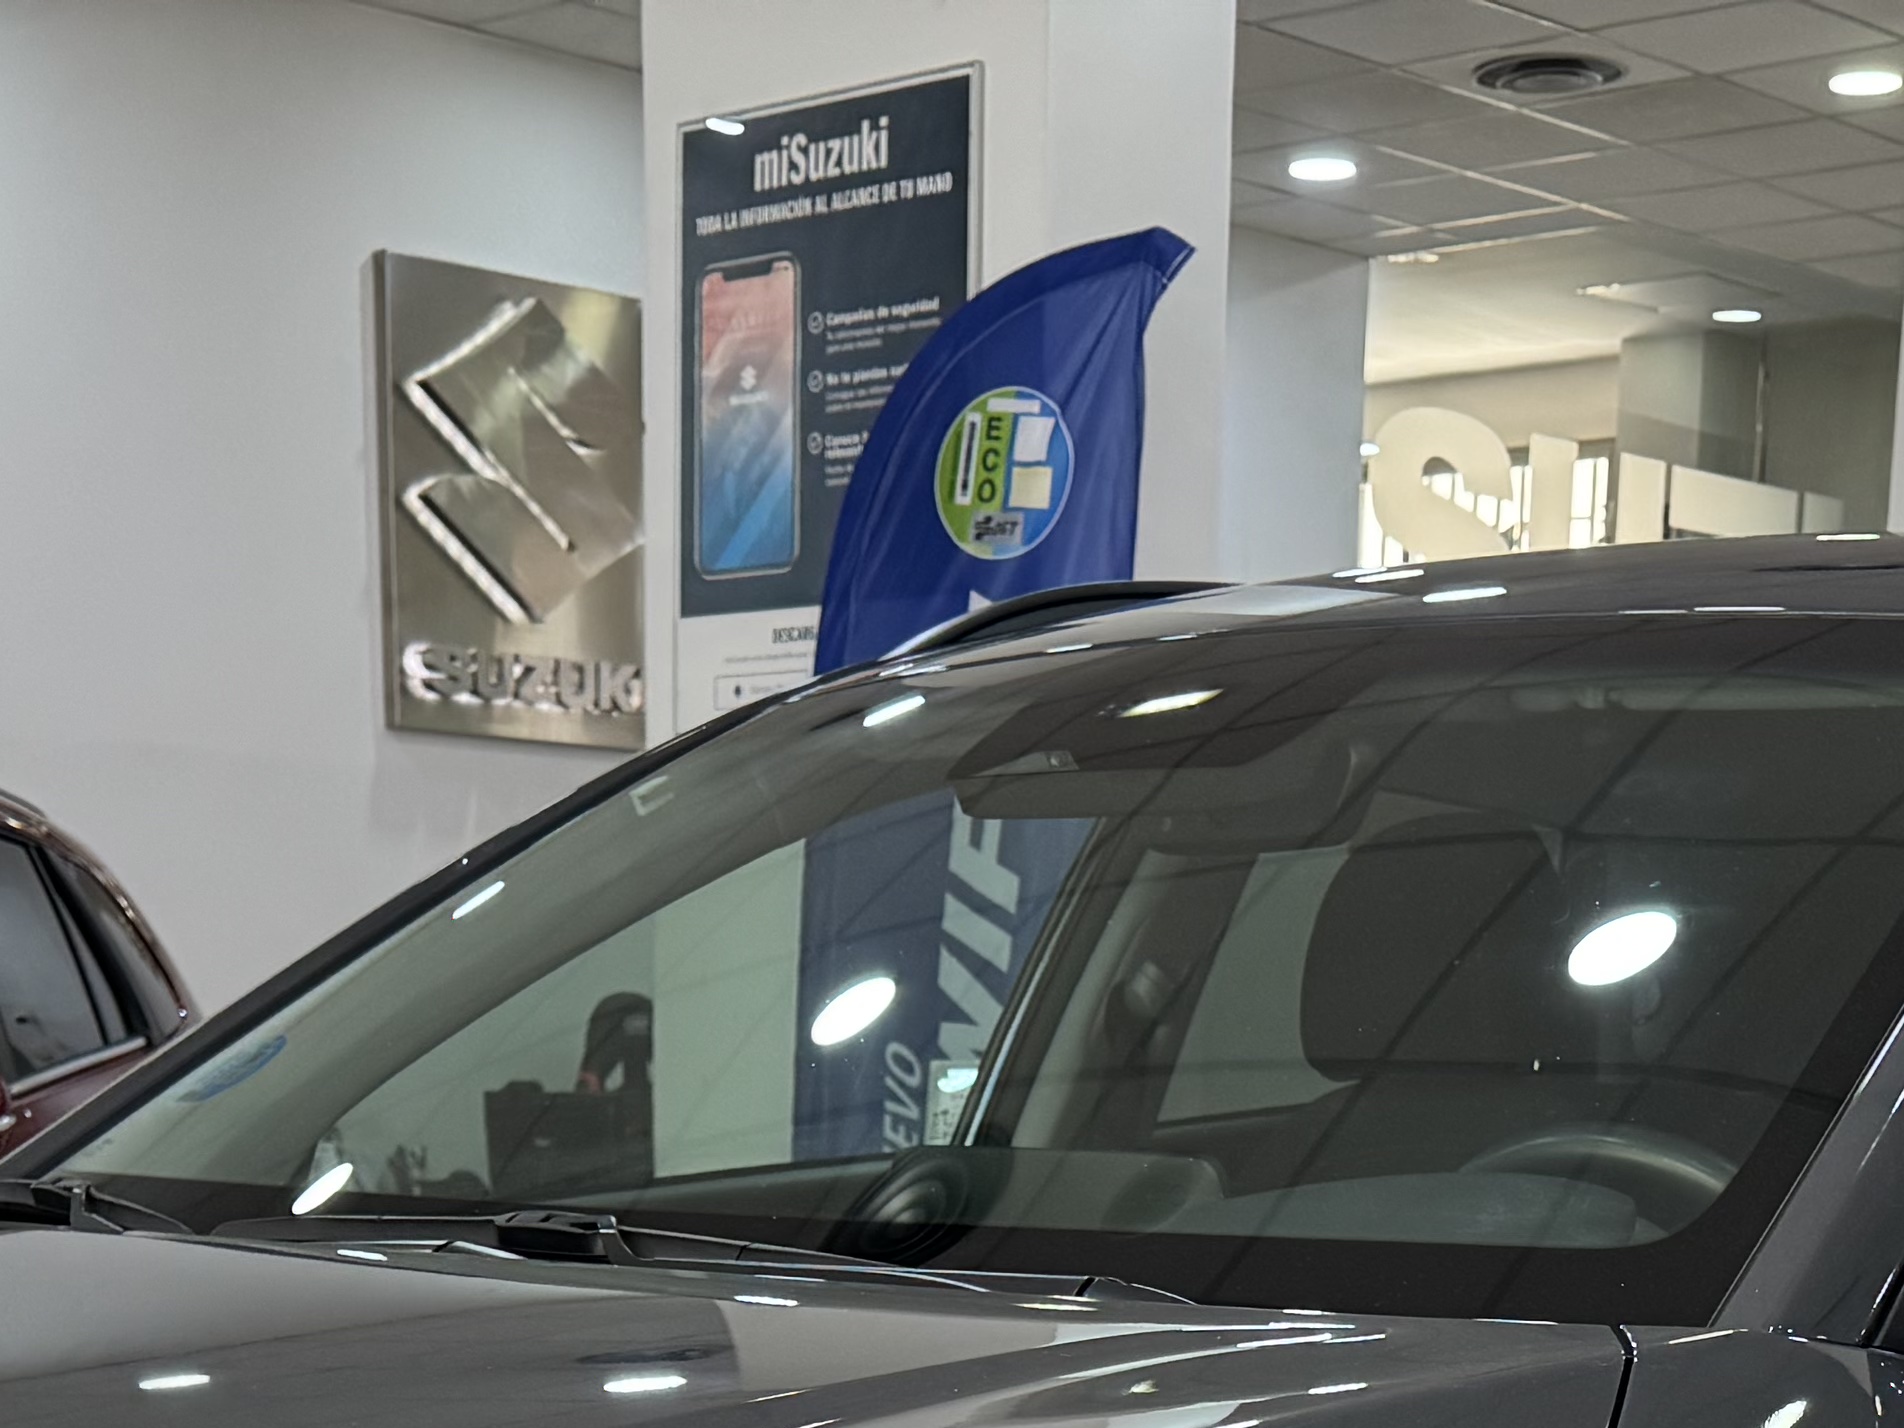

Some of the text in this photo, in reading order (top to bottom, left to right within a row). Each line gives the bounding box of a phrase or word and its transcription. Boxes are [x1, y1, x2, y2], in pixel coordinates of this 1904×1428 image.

[753, 115, 890, 193] miSuzuki
[723, 210, 739, 230] LA
[880, 181, 898, 204] DE
[898, 178, 915, 200] TU
[402, 641, 644, 716] SUZUK
[882, 1041, 923, 1154] EVO
